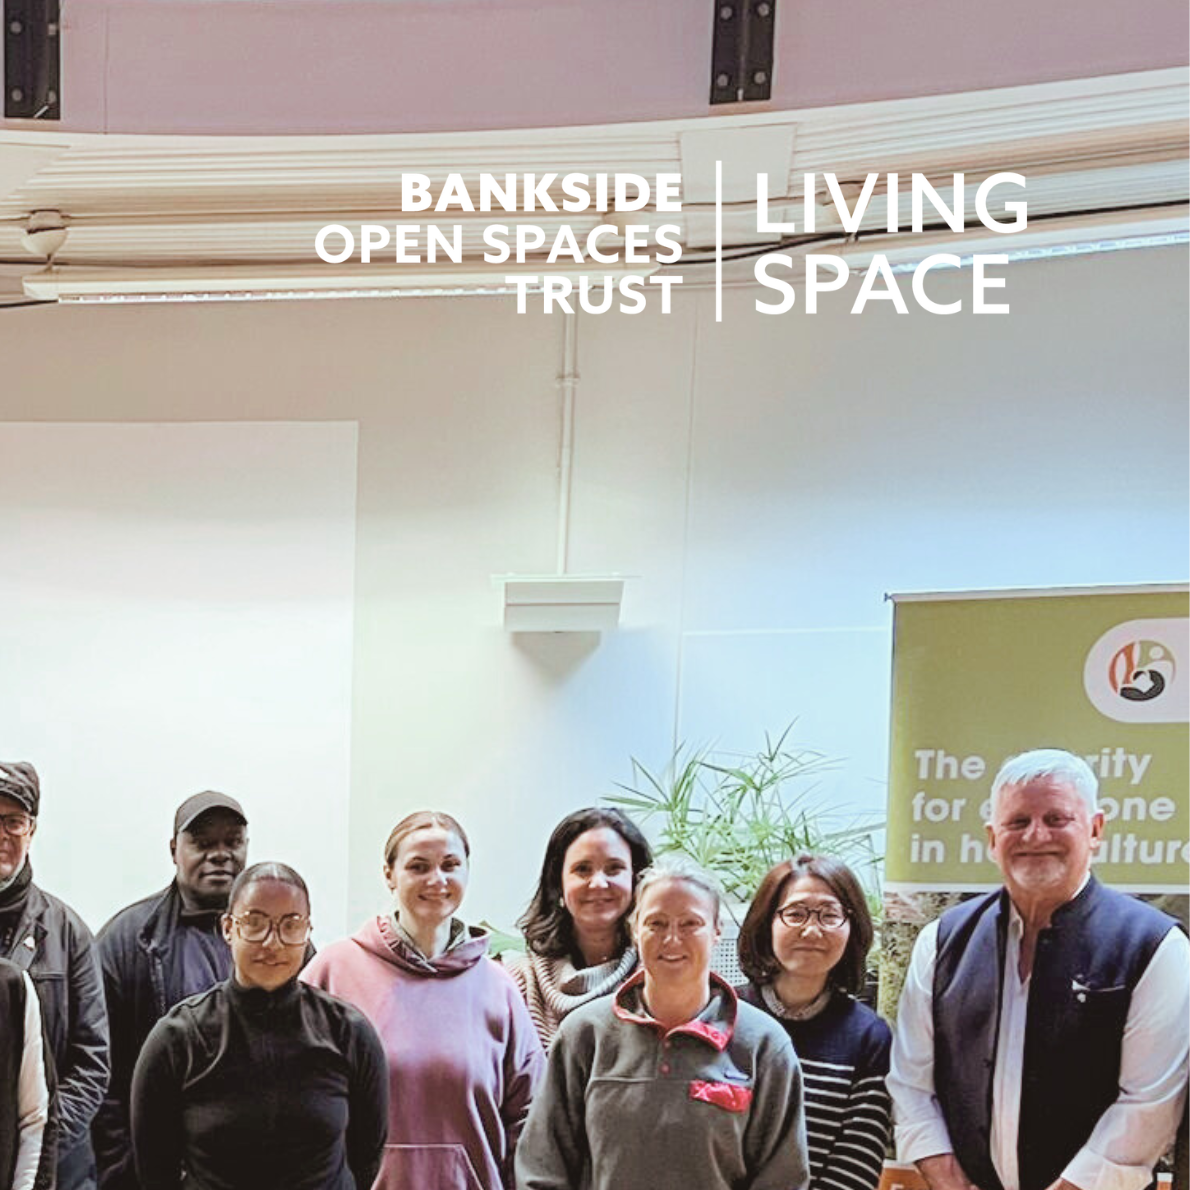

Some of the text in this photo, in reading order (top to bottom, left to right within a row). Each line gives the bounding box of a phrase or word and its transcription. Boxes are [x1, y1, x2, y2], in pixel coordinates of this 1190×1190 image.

[915, 749, 986, 780] The
[912, 791, 967, 822] for
[910, 833, 944, 863] in
